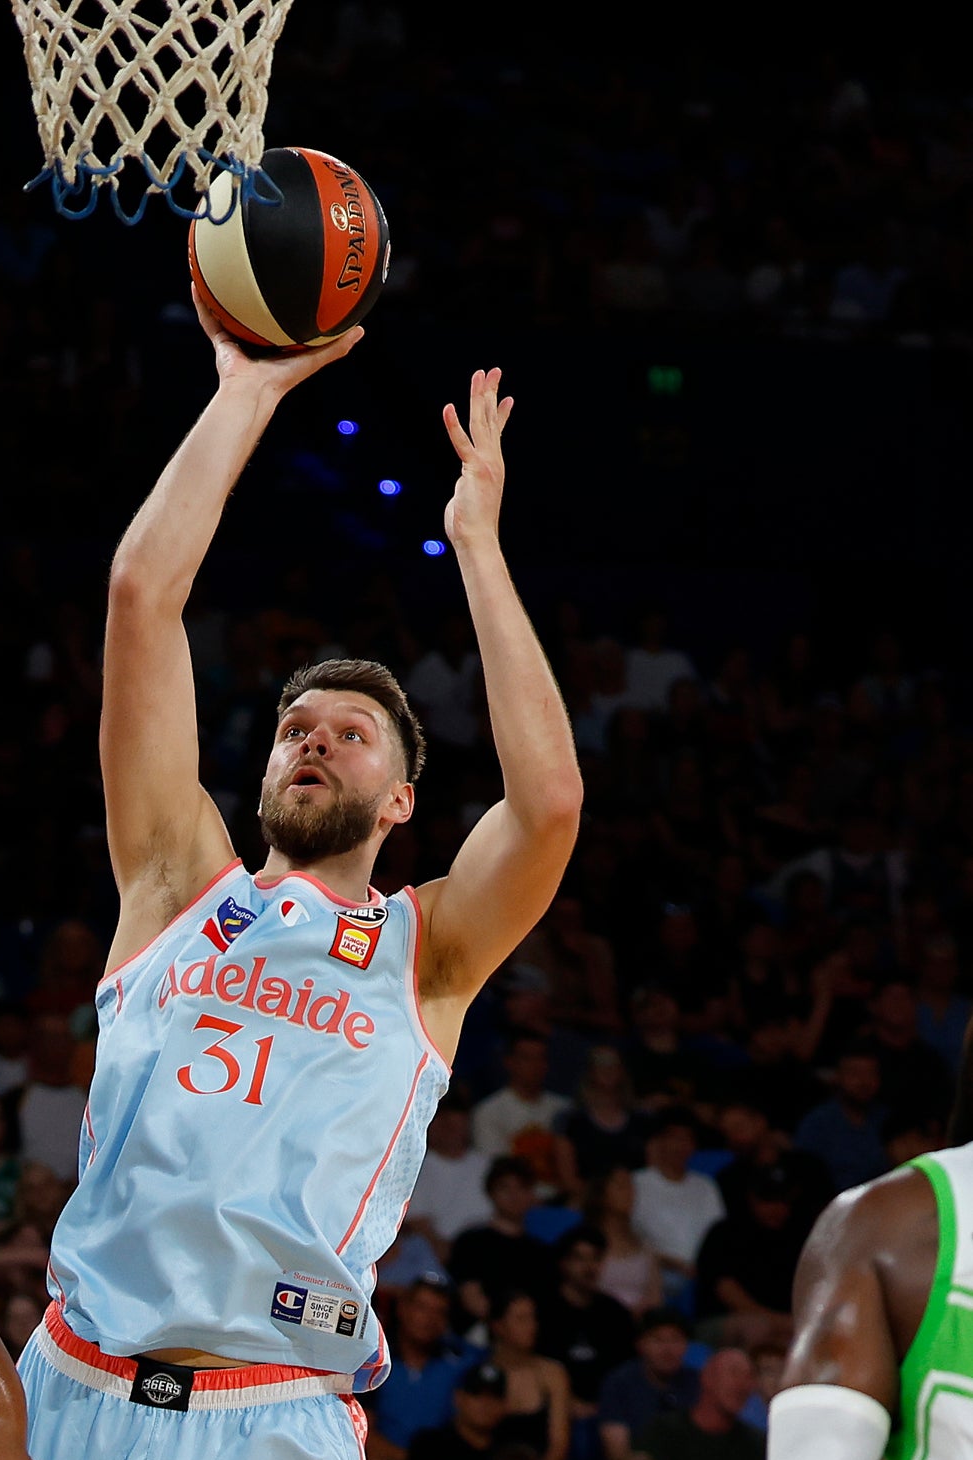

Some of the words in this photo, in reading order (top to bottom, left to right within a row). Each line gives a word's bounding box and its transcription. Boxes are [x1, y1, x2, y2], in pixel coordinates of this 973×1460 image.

[323, 161, 366, 293] SPALDING
[343, 935, 368, 948] HUNGRY
[158, 954, 375, 1049] Adelaide
[176, 1013, 275, 1106] 31
[326, 1279, 353, 1293] Edition
[310, 1302, 334, 1313] SINCE
[312, 1311, 329, 1320] 1919
[143, 1378, 182, 1396] 36ERS
